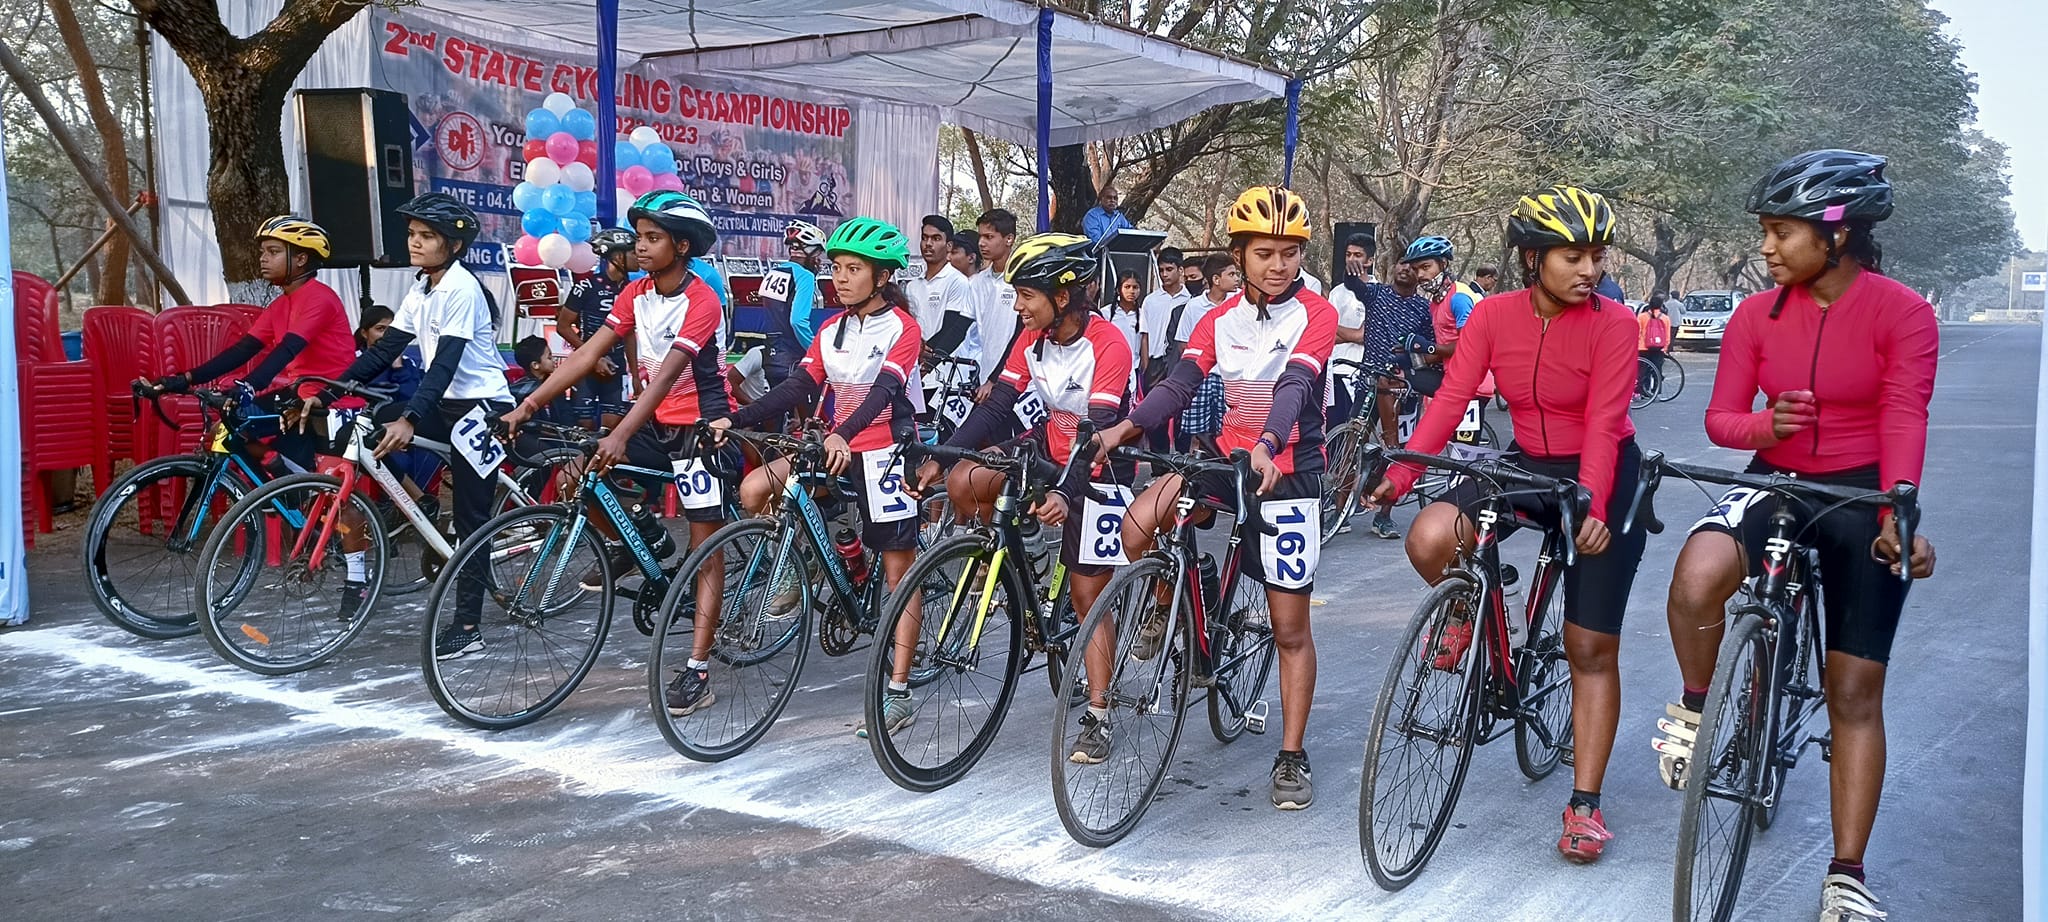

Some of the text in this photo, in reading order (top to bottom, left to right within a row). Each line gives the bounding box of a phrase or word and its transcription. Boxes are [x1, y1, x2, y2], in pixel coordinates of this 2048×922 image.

[384, 21, 850, 137] 2nd STATE CYING CHAMPIONSHIP
[492, 124, 525, 147] You
[696, 157, 732, 179] (Boys
[737, 161, 747, 177] &
[751, 163, 787, 184] Girls)
[711, 187, 722, 203] &
[726, 188, 773, 207] Women
[712, 216, 750, 231] CENTRAL
[765, 275, 787, 295] 145
[877, 452, 908, 514] 161
[1094, 491, 1126, 558] 163
[1276, 506, 1306, 581] 162
